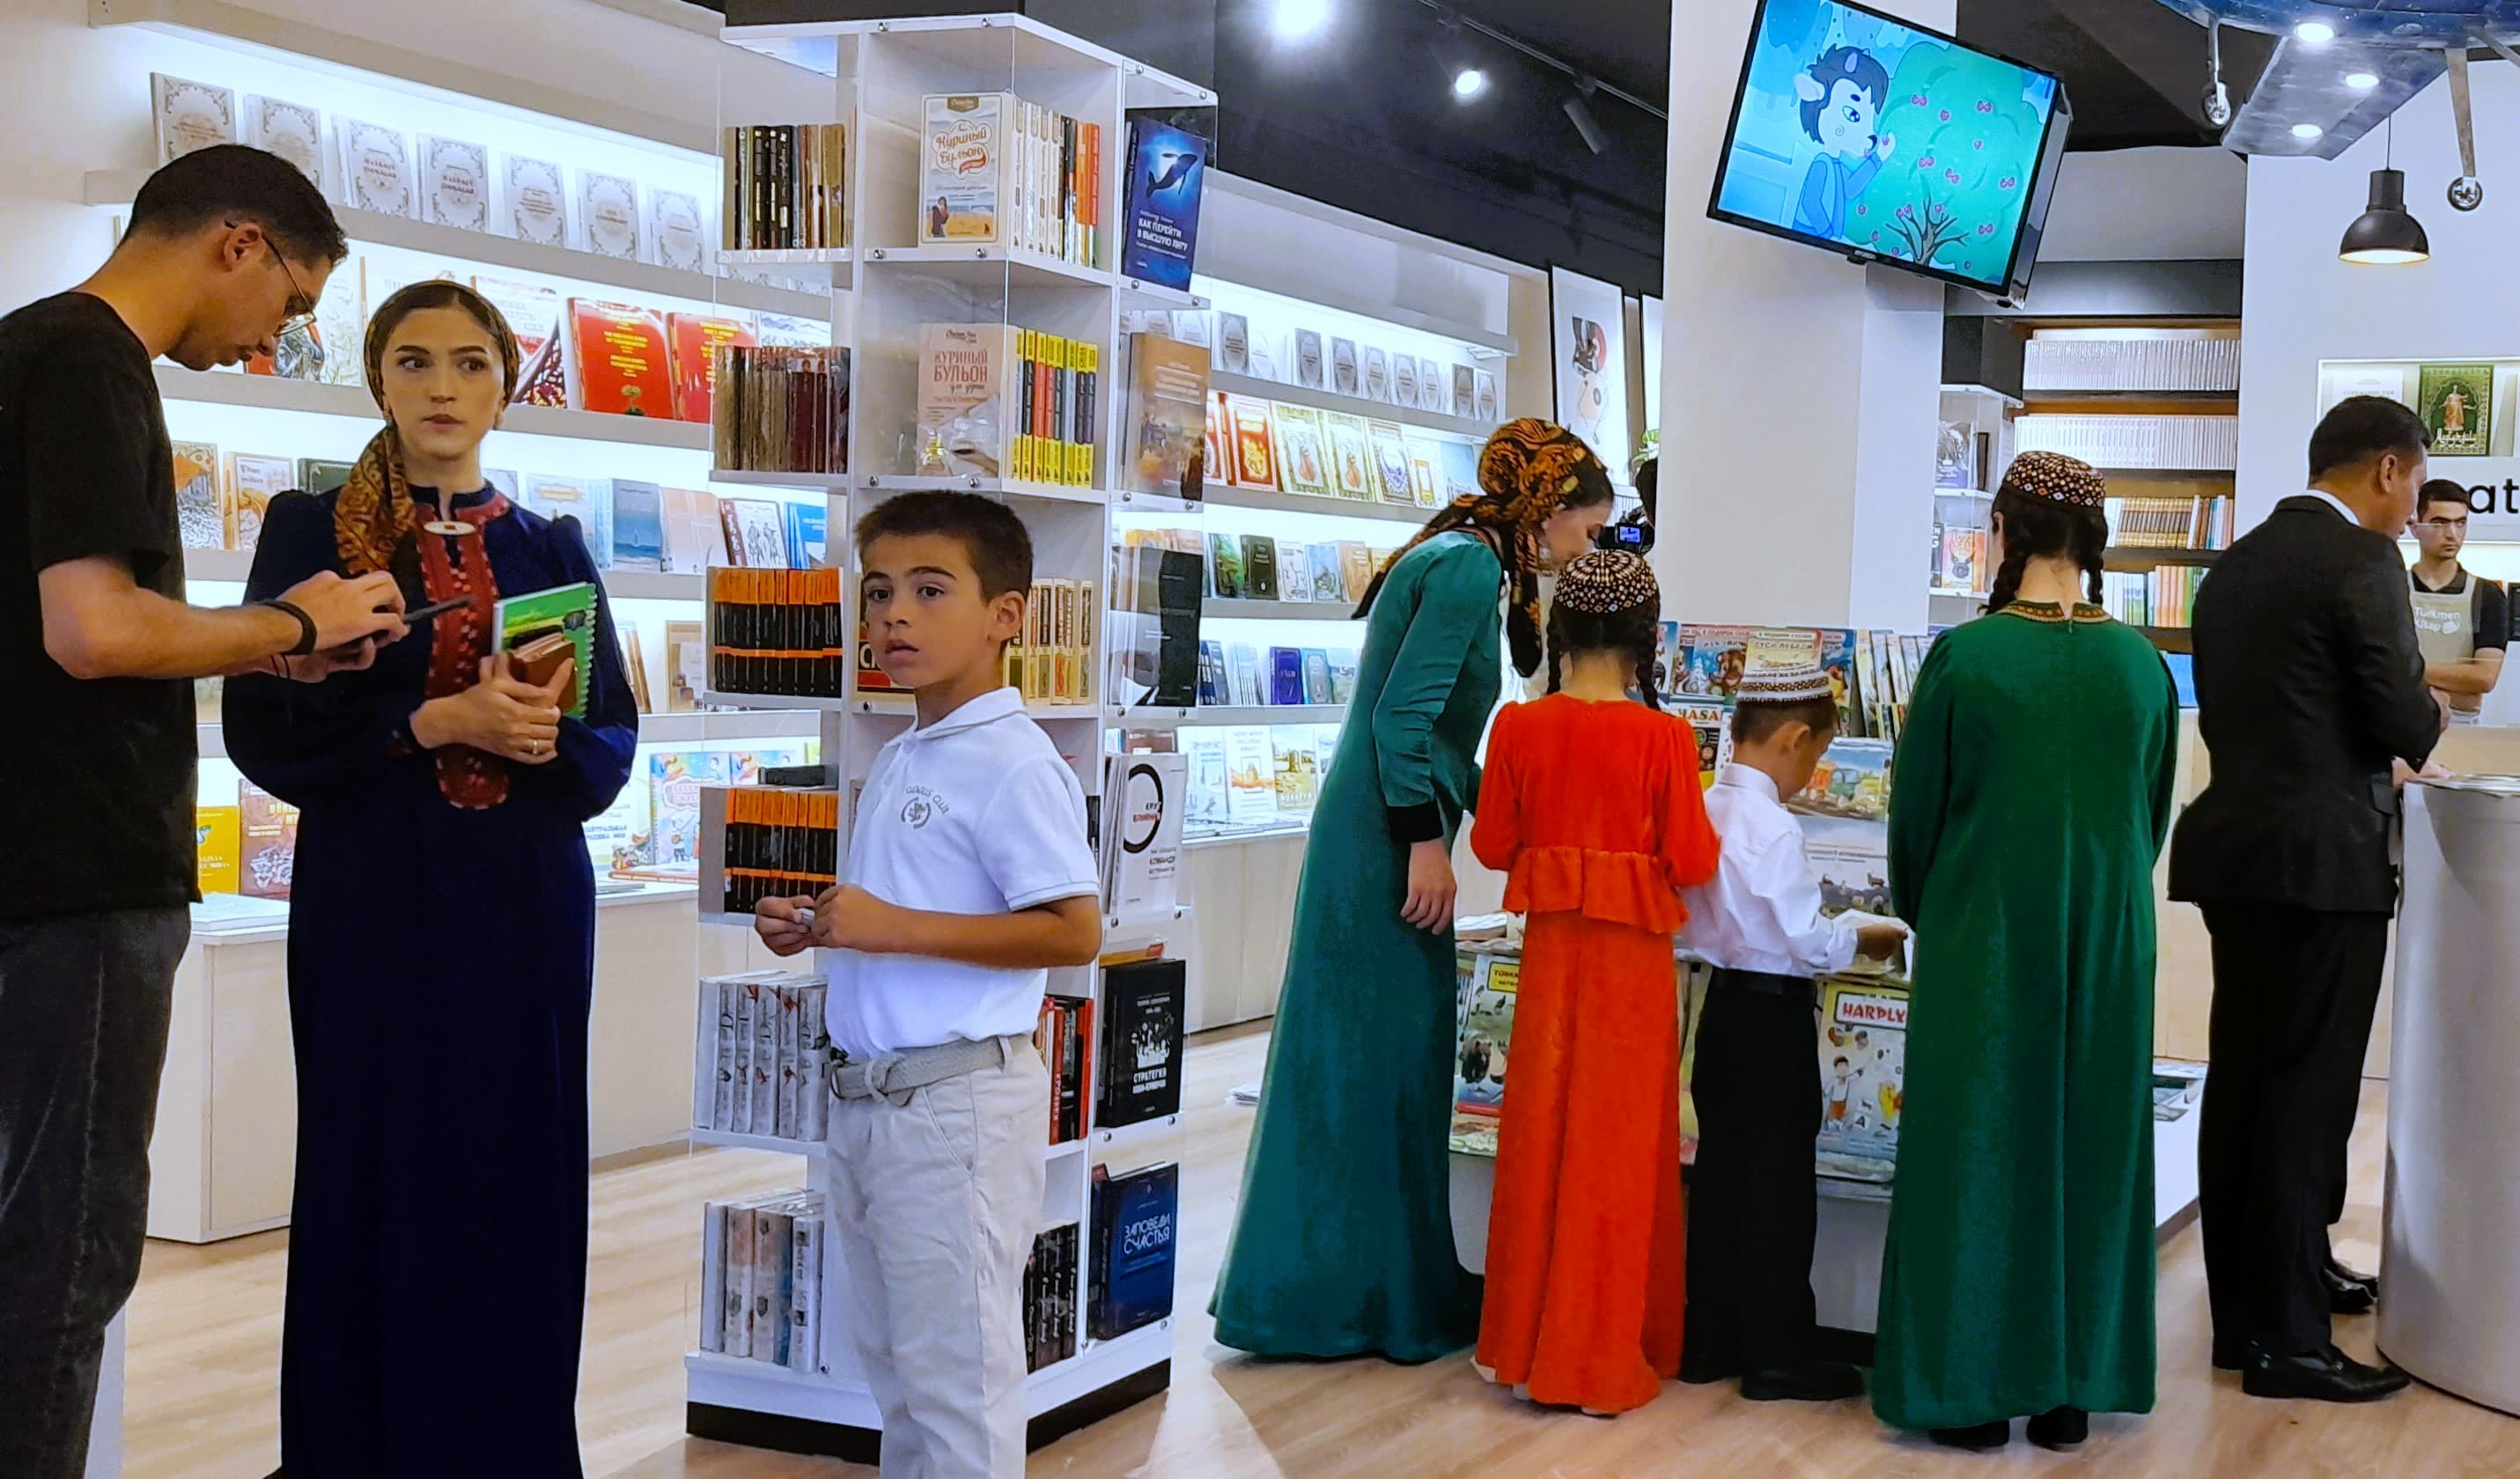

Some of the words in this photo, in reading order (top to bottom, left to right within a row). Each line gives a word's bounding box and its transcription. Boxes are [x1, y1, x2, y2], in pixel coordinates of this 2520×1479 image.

[933, 365, 988, 382] БУЛЬОН
[1124, 1213, 1170, 1239] ЗАПОВЕДИ
[1124, 1226, 1170, 1255] СЧАСТЬЯ
